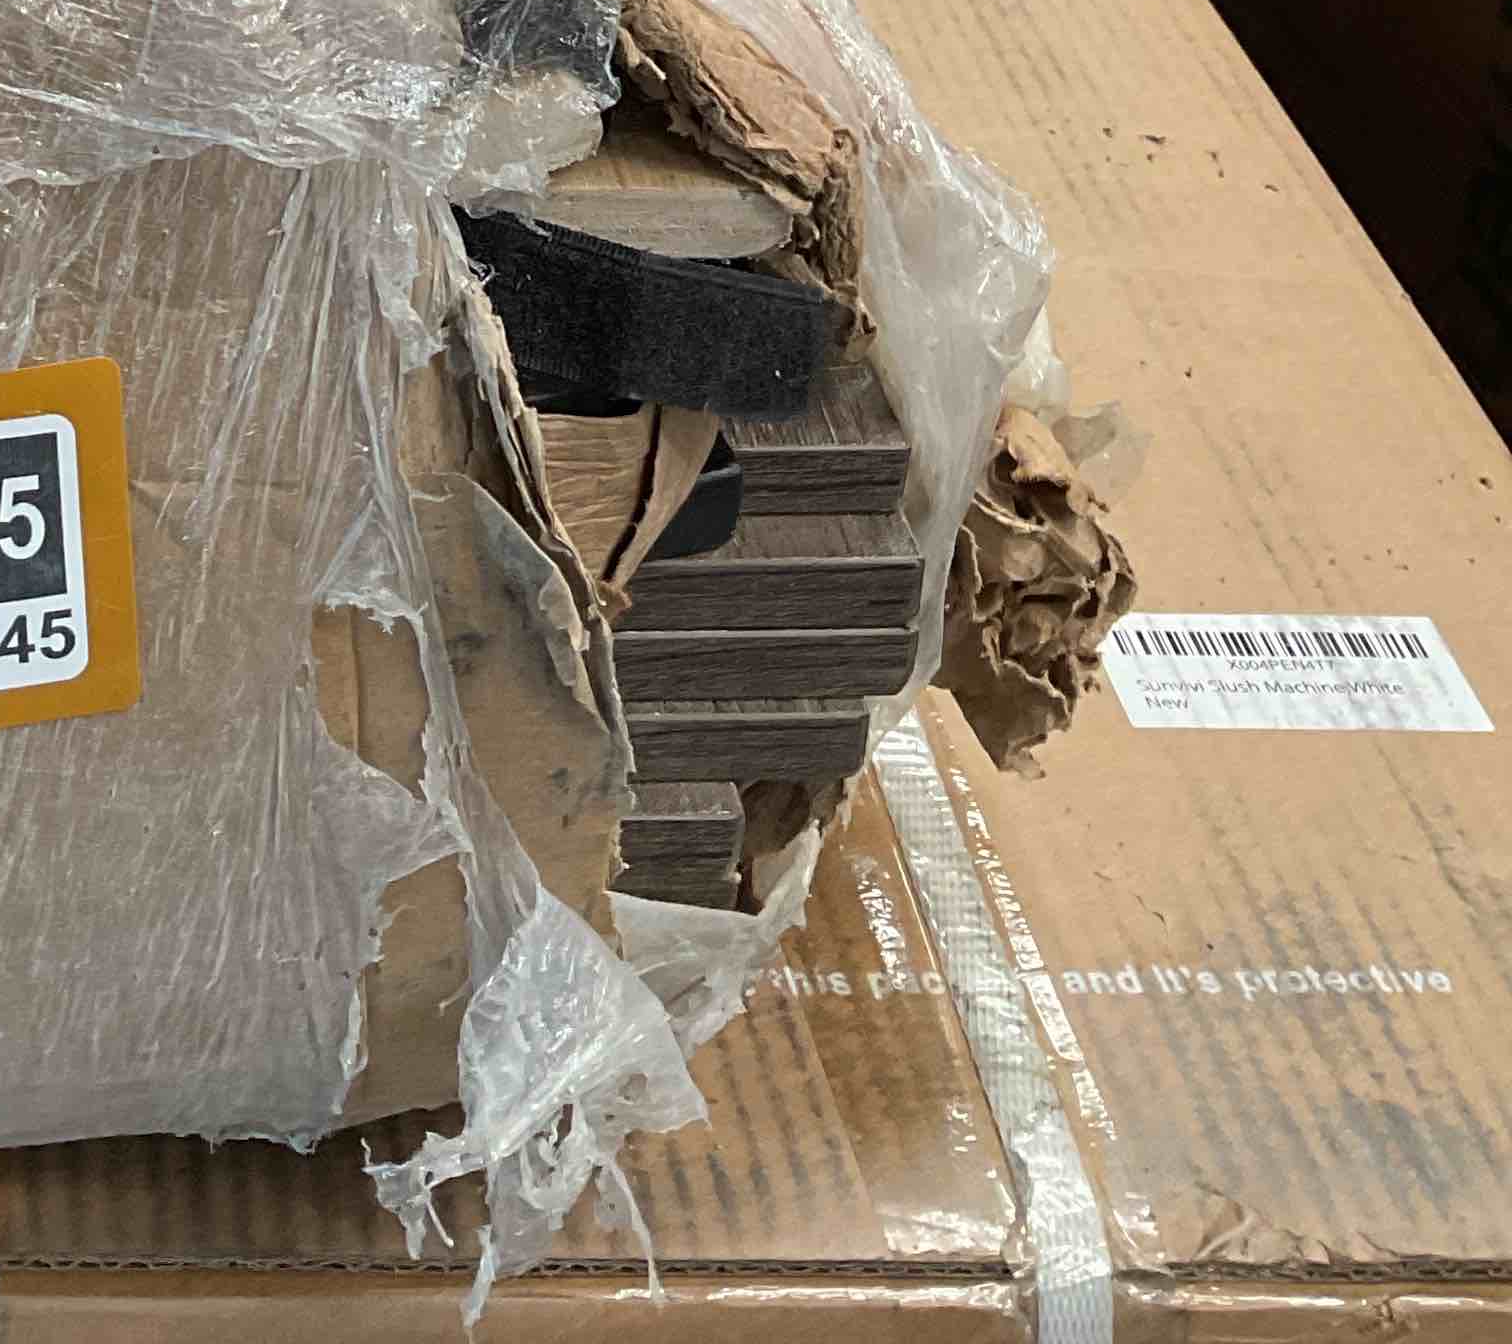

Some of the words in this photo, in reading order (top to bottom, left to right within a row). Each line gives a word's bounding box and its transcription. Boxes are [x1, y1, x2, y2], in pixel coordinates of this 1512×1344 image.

[1210, 678, 1261, 694] Slush
[1144, 695, 1190, 710] New
[1061, 963, 1144, 994] and
[1233, 963, 1454, 1001] protective
